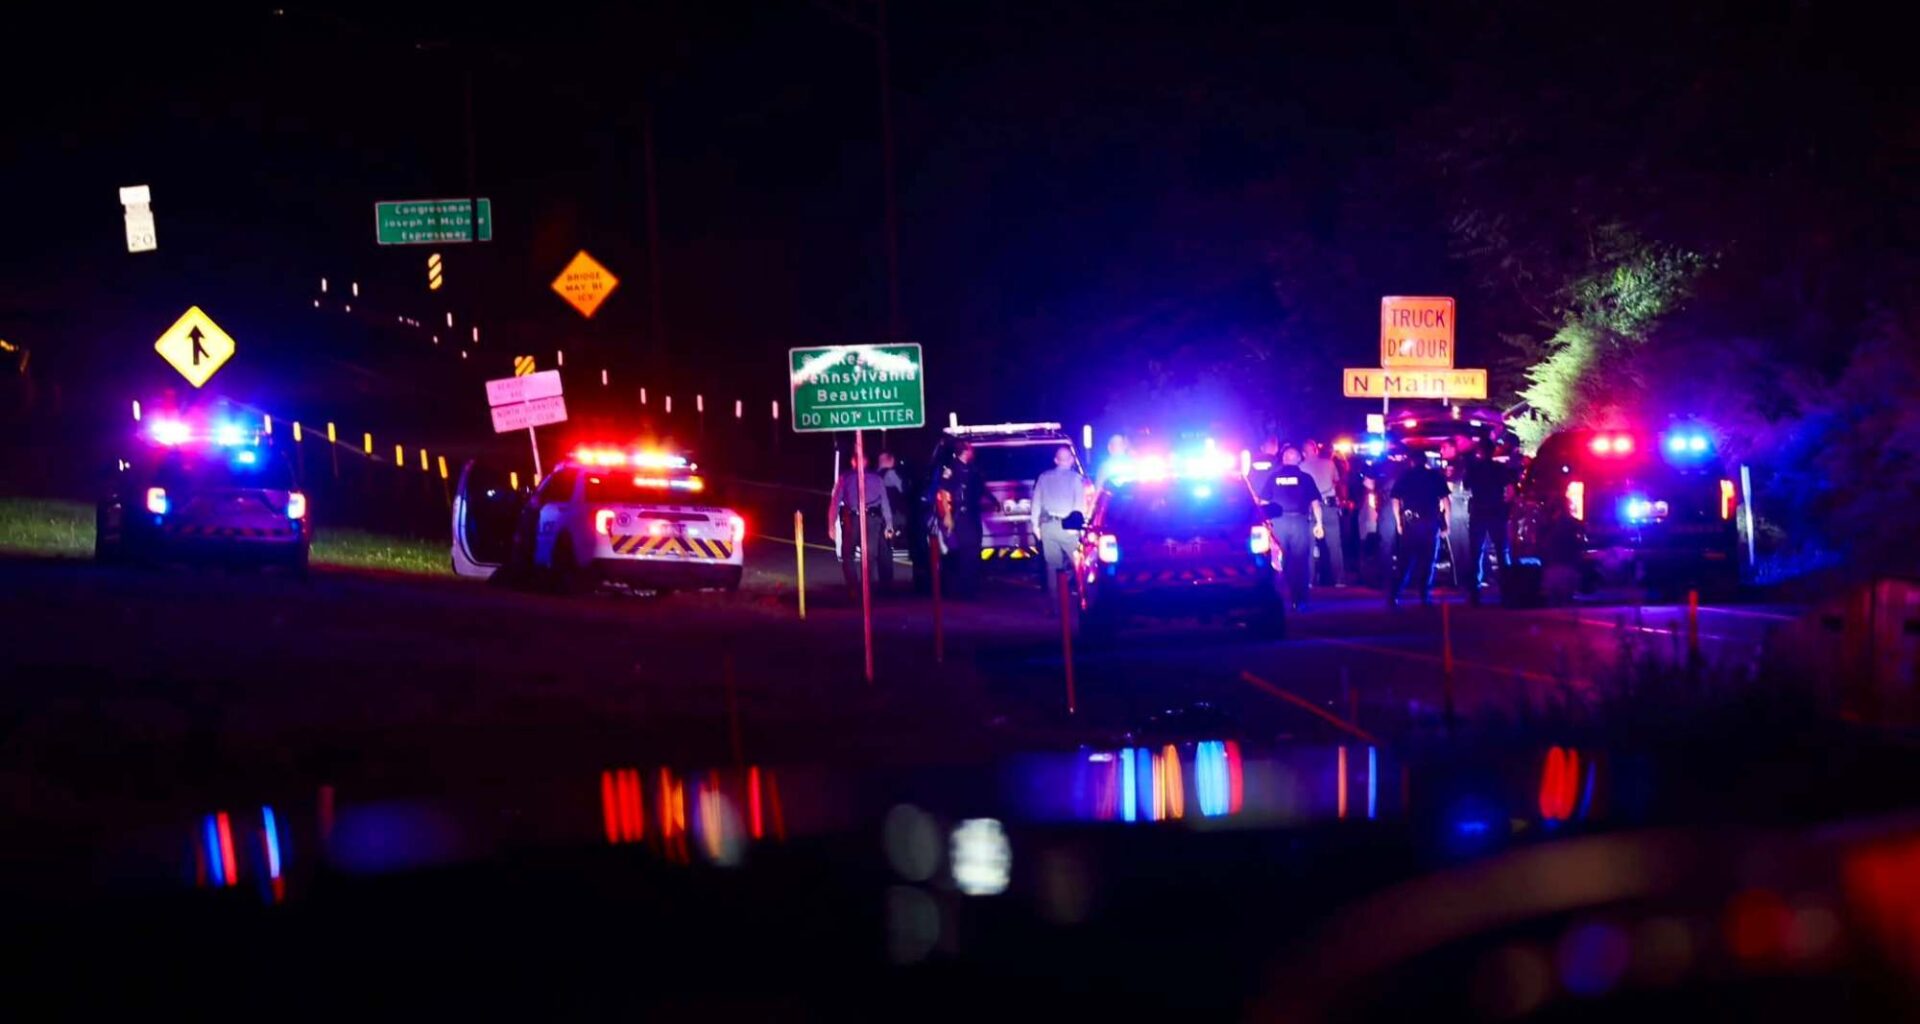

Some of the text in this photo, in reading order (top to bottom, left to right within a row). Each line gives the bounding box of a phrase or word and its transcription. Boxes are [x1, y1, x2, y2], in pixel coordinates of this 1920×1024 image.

[395, 204, 471, 215] Congressman
[384, 218, 423, 229] Joseph
[440, 216, 485, 226] McDae
[131, 233, 153, 248] 20
[401, 230, 467, 242] Expressway
[567, 271, 599, 282] BRIDGE
[565, 281, 603, 291] MAY BE
[1391, 308, 1445, 328] TRUCK
[800, 368, 916, 386] ennsylvania
[1353, 375, 1368, 392] N
[1384, 374, 1445, 392] Main
[817, 386, 899, 403] Beautiful
[802, 408, 915, 426] DO NOT LITTER
